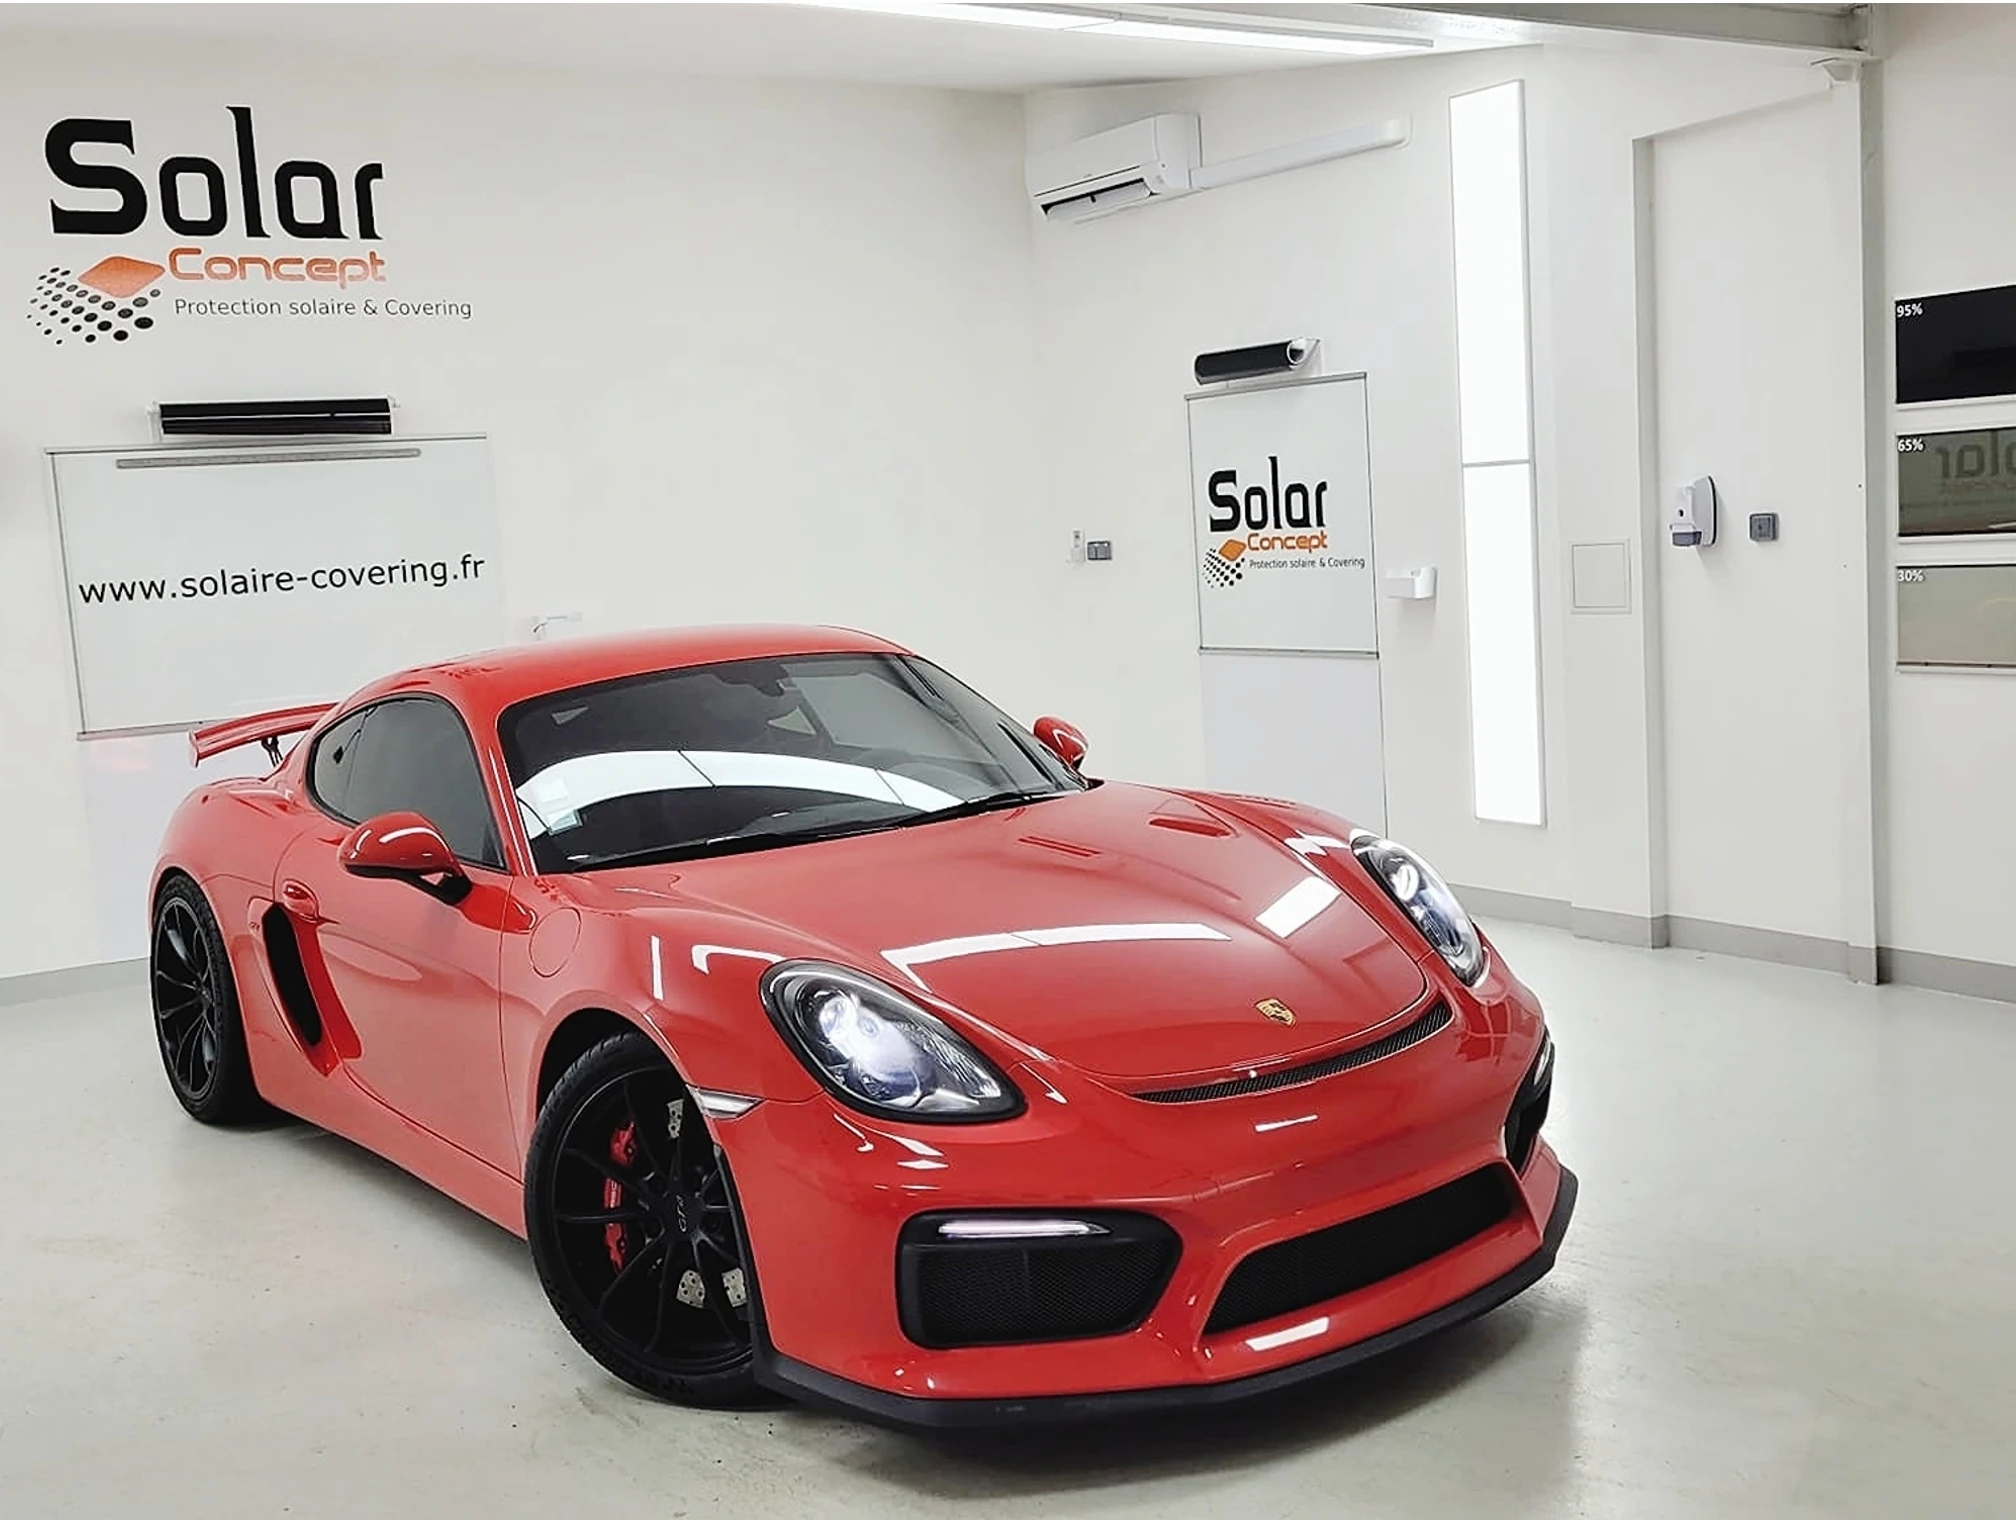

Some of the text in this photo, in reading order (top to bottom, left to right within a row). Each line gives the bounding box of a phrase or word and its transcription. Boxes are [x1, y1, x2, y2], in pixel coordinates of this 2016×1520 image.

[44, 106, 384, 239] Solar
[168, 247, 387, 290] Concept
[174, 297, 472, 320] Protection solaire & Covering
[1896, 303, 1923, 317] 95%
[1897, 437, 1925, 452] 65%
[1207, 456, 1328, 533] Solar
[1247, 530, 1328, 554] Concept
[1249, 557, 1365, 569] Protection solaire & Covering
[79, 553, 486, 604] www.solaire-covering.fr
[1897, 569, 1924, 583] 30%
